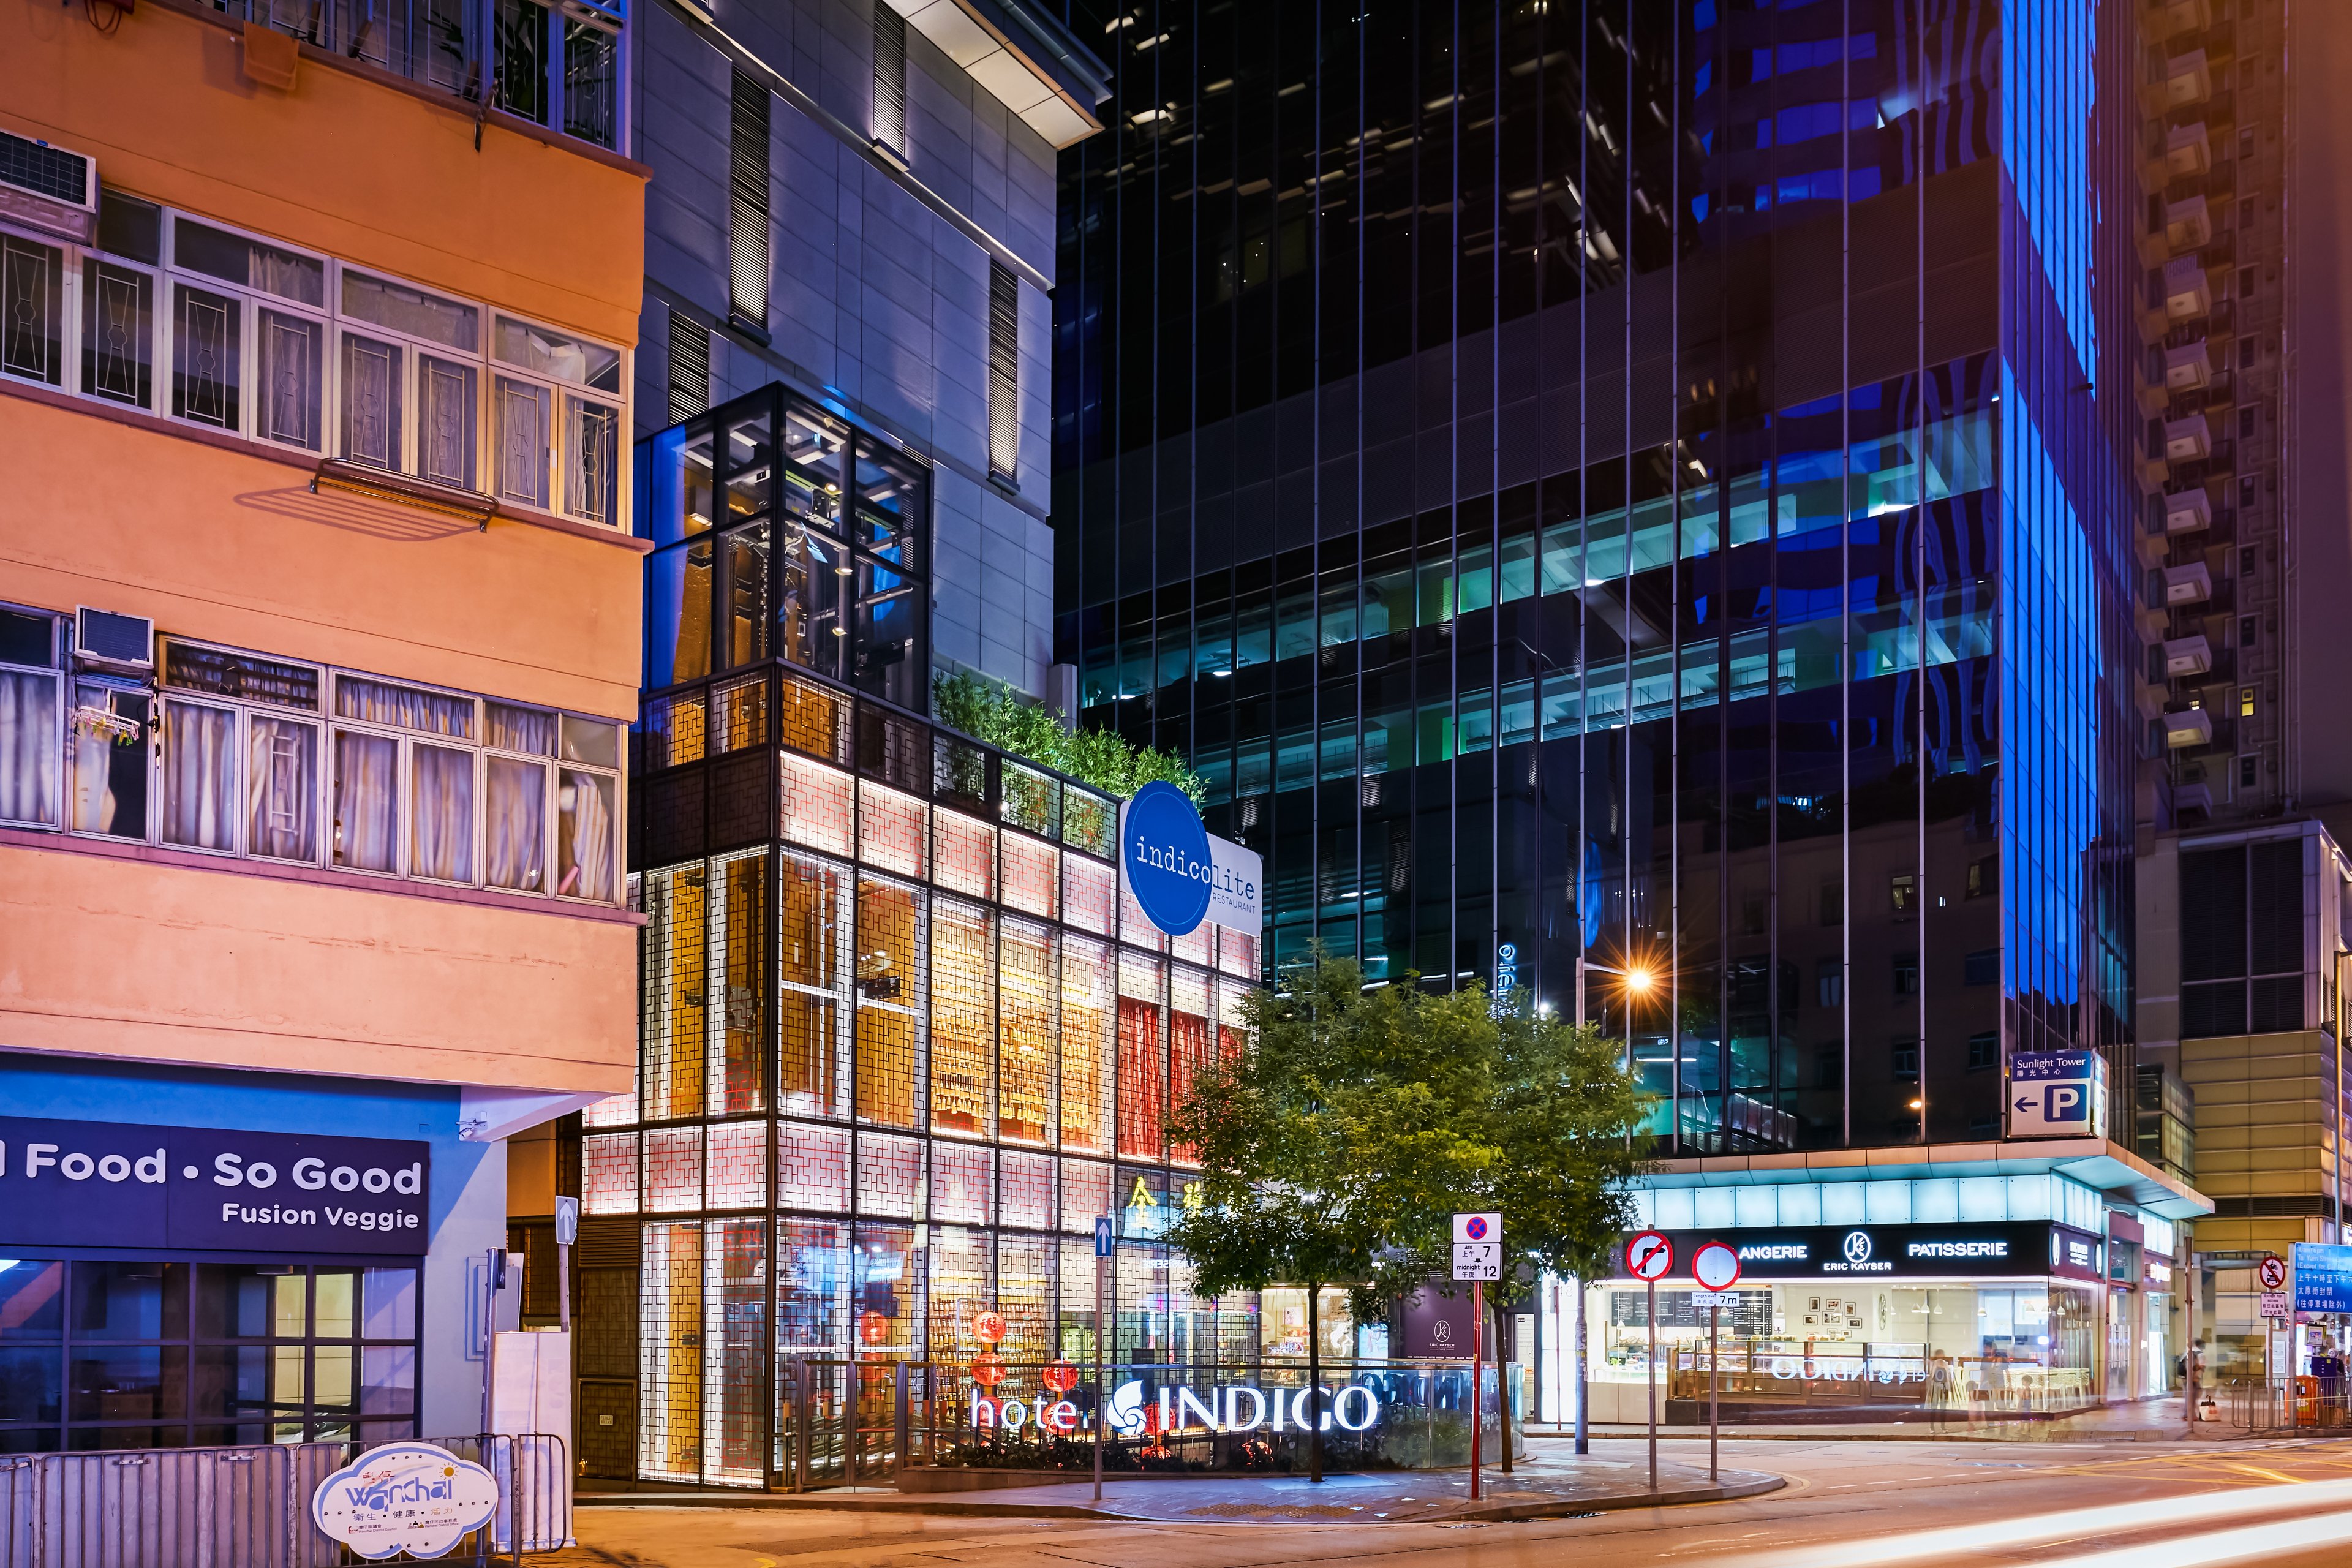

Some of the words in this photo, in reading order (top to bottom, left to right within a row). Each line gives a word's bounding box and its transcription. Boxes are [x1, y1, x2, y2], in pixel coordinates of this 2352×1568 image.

[1137, 835, 1254, 900] indicolite
[1212, 892, 1256, 914] RESTAURANT
[2017, 1058, 2054, 1070] Sunlight
[2056, 1058, 2086, 1067] Tower
[2016, 1068, 2061, 1077] 陽光中心
[2052, 1088, 2079, 1118] P
[26, 1143, 166, 1183] Food
[214, 1153, 277, 1188] So
[292, 1157, 421, 1195] Good
[222, 1203, 317, 1225] Fusion
[325, 1207, 419, 1231] Veggie
[1483, 1246, 1491, 1257] 7
[1739, 1246, 1807, 1259] ANGERIE
[1908, 1242, 2008, 1256] PATISSERIE
[1483, 1265, 1496, 1277] 12
[1851, 1262, 1892, 1271] KAYSER
[2298, 1286, 2332, 1296] 太原街封閉
[970, 1388, 1089, 1430] hotel
[1159, 1385, 1378, 1431] INDIGO
[353, 1512, 376, 1521] 衛生
[393, 1509, 416, 1518] 健康
[431, 1506, 453, 1515] 活力
